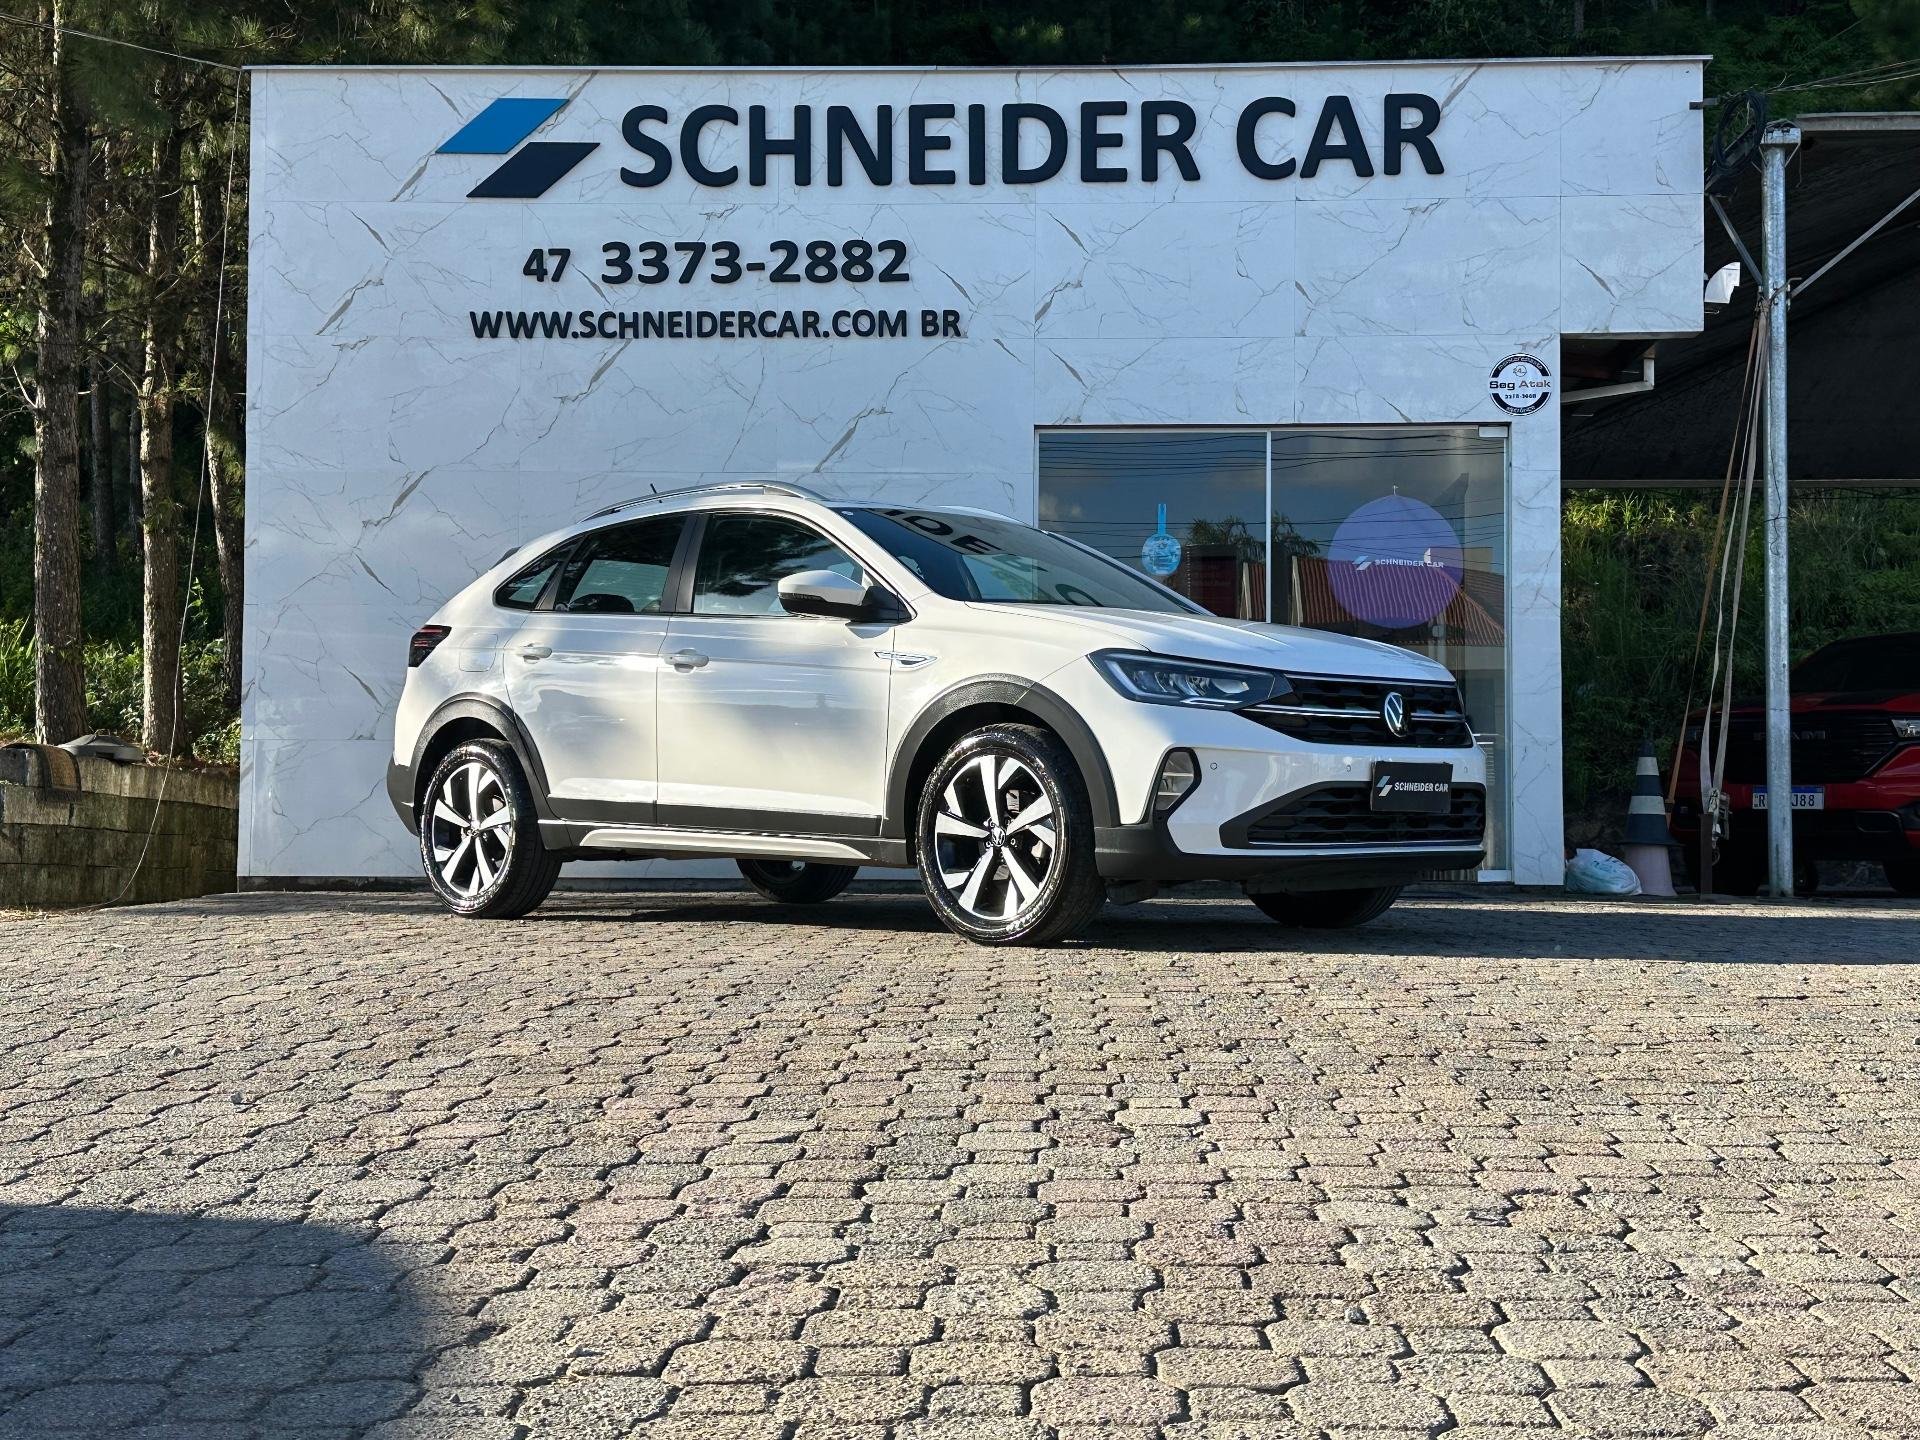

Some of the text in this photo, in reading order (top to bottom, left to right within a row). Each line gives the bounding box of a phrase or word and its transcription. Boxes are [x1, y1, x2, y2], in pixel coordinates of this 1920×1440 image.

[619, 92, 1446, 188] SCHNEIDER CAR
[522, 239, 910, 284] 47 3373-2882
[469, 309, 961, 339] WWW.SCHNEIDERCAR.COM BR
[1489, 380, 1551, 390] Seg Atak
[1394, 781, 1449, 793] SCHNEIDER CAR
[1758, 794, 1815, 807] RJ88
